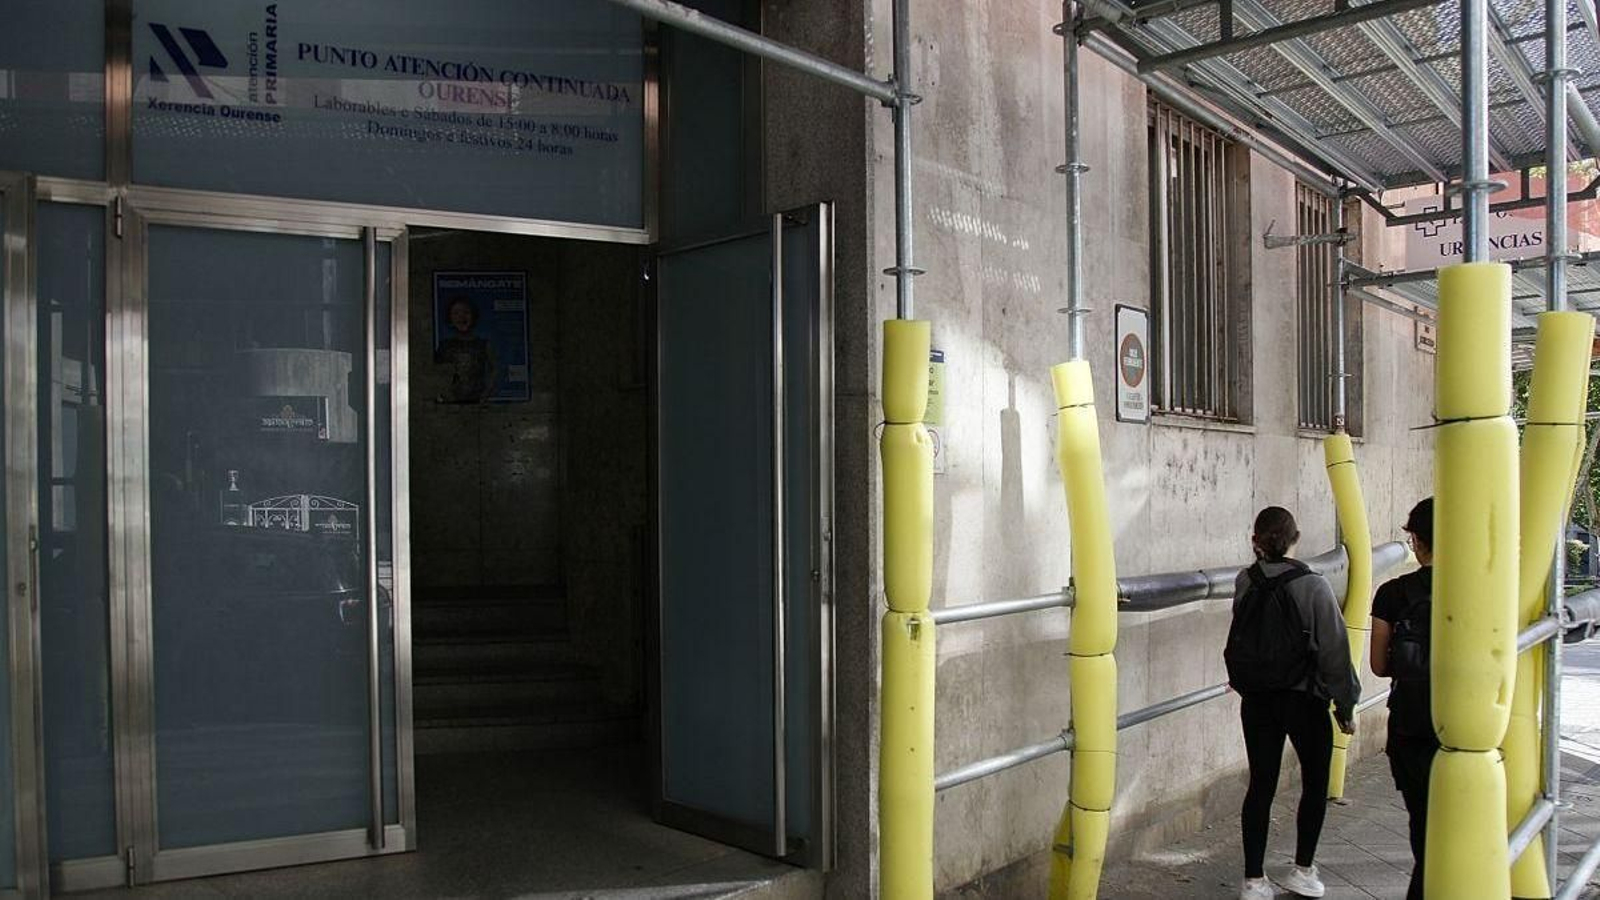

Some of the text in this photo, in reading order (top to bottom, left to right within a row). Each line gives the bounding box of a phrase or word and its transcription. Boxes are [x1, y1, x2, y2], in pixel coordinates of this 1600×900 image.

[265, 3, 278, 105] PRIMARIA
[297, 42, 630, 103] PUNTO ATENCIÓN CONTINUADA
[148, 96, 281, 123] Xerencia Ourense
[314, 95, 397, 117] Laborables
[401, 107, 409, 118] e
[477, 116, 493, 127] de
[540, 123, 547, 134] a
[584, 126, 619, 142] horas
[368, 120, 443, 143] Domingos
[518, 136, 533, 151] 24
[538, 138, 574, 155] horas
[1440, 231, 1543, 257] URNCIAS
